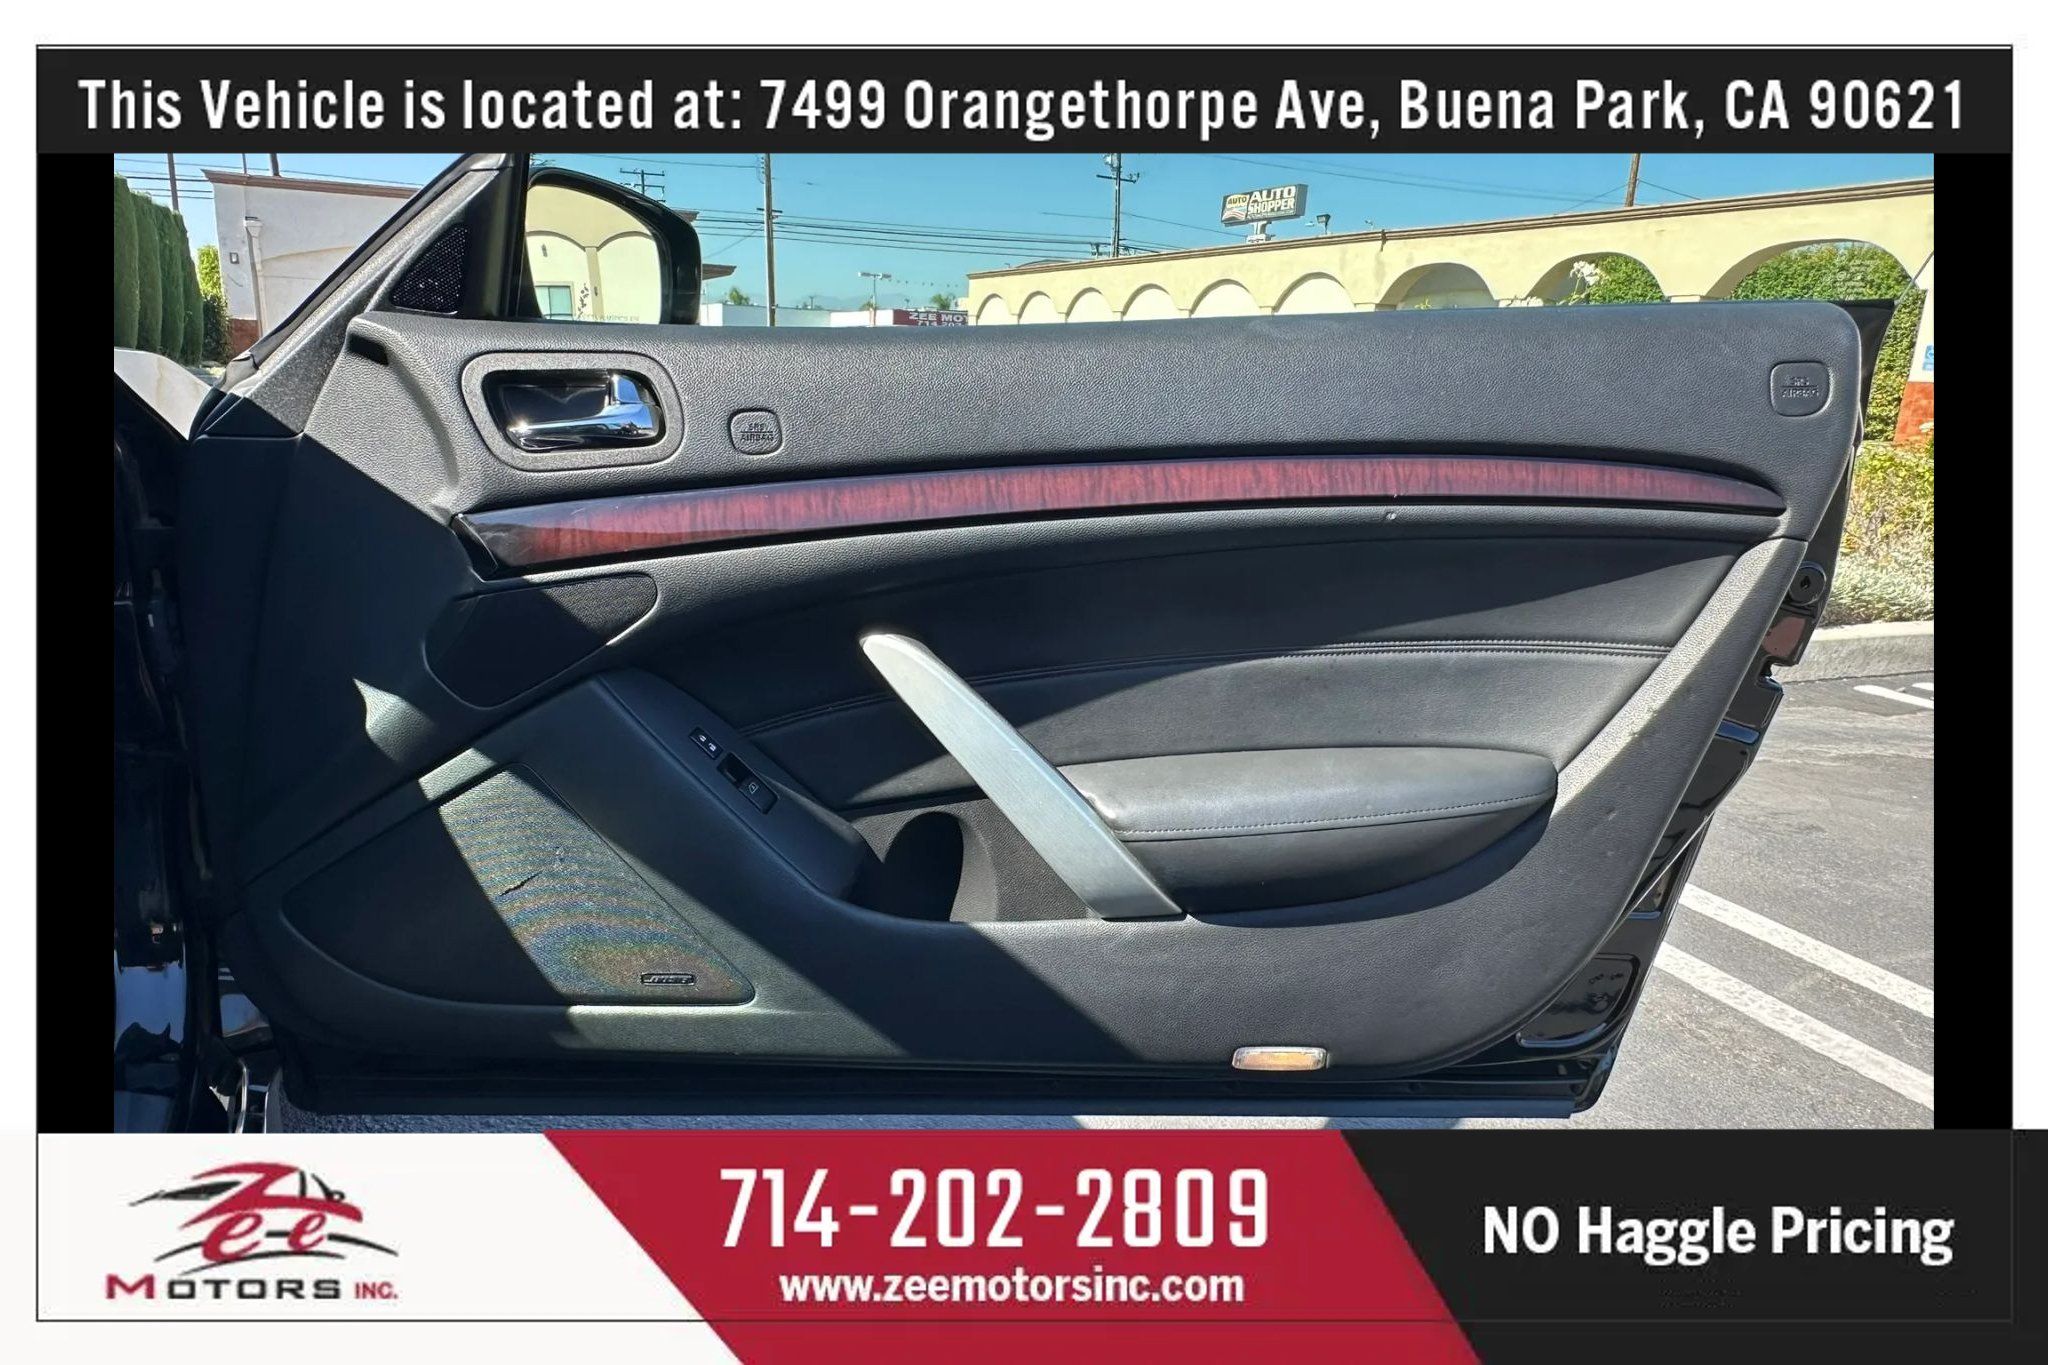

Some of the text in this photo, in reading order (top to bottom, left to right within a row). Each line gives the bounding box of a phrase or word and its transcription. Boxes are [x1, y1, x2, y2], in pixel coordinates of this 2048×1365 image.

[1251, 186, 1297, 201] AUTO
[1228, 196, 1247, 205] AUTO
[1248, 198, 1295, 214] SHOPPER
[908, 312, 938, 321] ZEE
